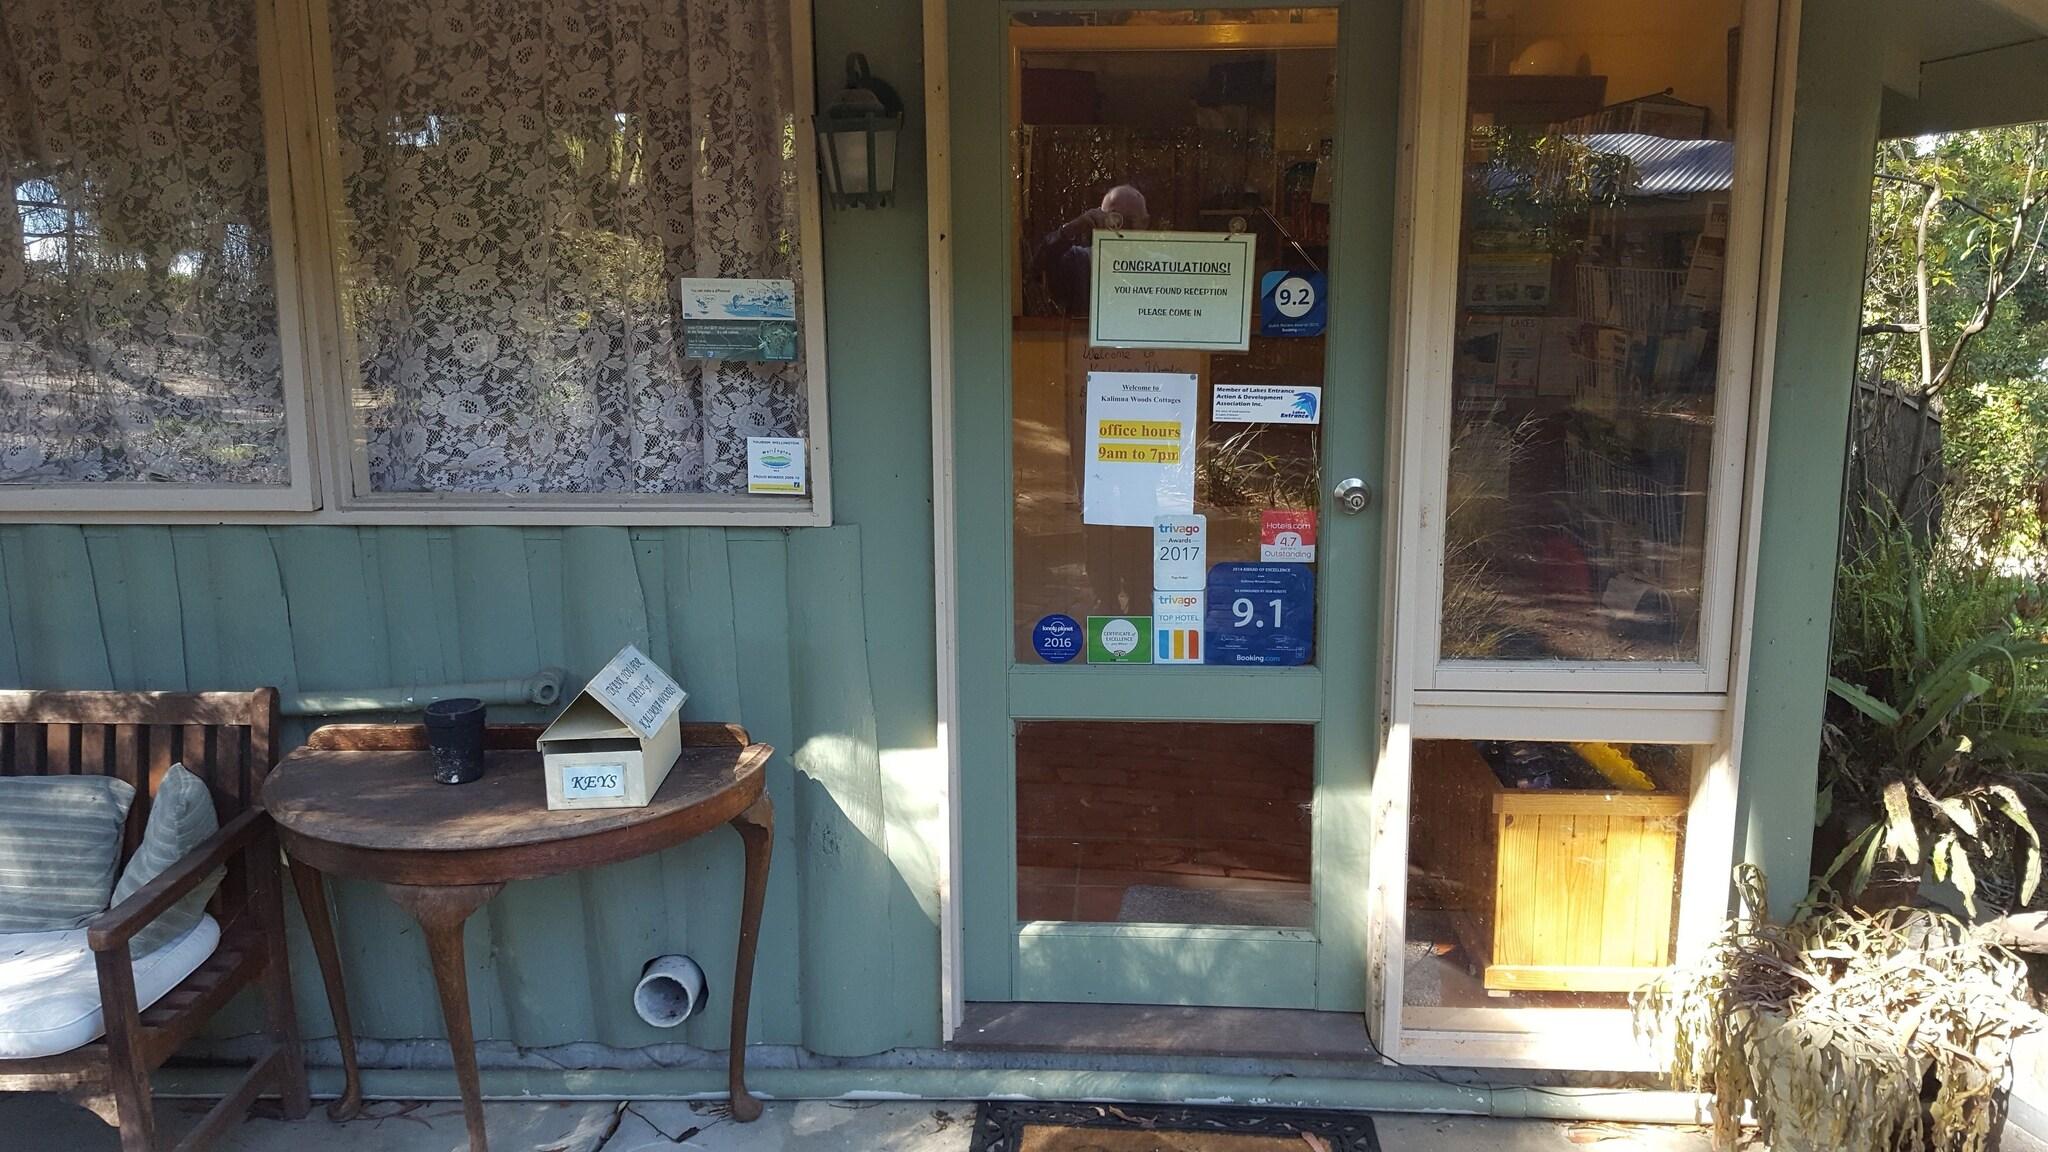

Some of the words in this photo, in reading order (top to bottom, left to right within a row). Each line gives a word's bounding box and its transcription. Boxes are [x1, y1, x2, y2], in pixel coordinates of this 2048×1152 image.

[1113, 260, 1231, 274] CONGRATULATIONS!
[1114, 286, 1130, 294] YOU
[1133, 286, 1155, 295] HAVE
[1156, 287, 1181, 295] FOUND
[1184, 288, 1228, 296] RECEPTION
[1279, 289, 1310, 306] 9.2
[1138, 308, 1167, 316] PLEASE
[1169, 308, 1191, 316] COME
[1194, 309, 1202, 317] IN
[1101, 395, 1129, 403] Kalimna
[1130, 396, 1152, 404] Woods
[1153, 397, 1182, 405] Cottages
[1099, 424, 1137, 437] office
[1142, 425, 1180, 437] hours
[1098, 446, 1128, 459] 9am
[1133, 448, 1146, 460] to
[1150, 448, 1178, 463] 7pm
[1159, 523, 1200, 536] trivago
[1280, 536, 1297, 547] 4.7
[1160, 546, 1200, 561] 2017
[1264, 550, 1312, 559] Outstanding
[1158, 595, 1197, 607] trivago
[1232, 598, 1282, 628] 9.1
[1042, 625, 1057, 633] lonely
[1058, 625, 1073, 633] planet
[1044, 637, 1072, 648] 2016
[1236, 654, 1281, 663] Booking.com
[571, 774, 618, 791] KEYS
